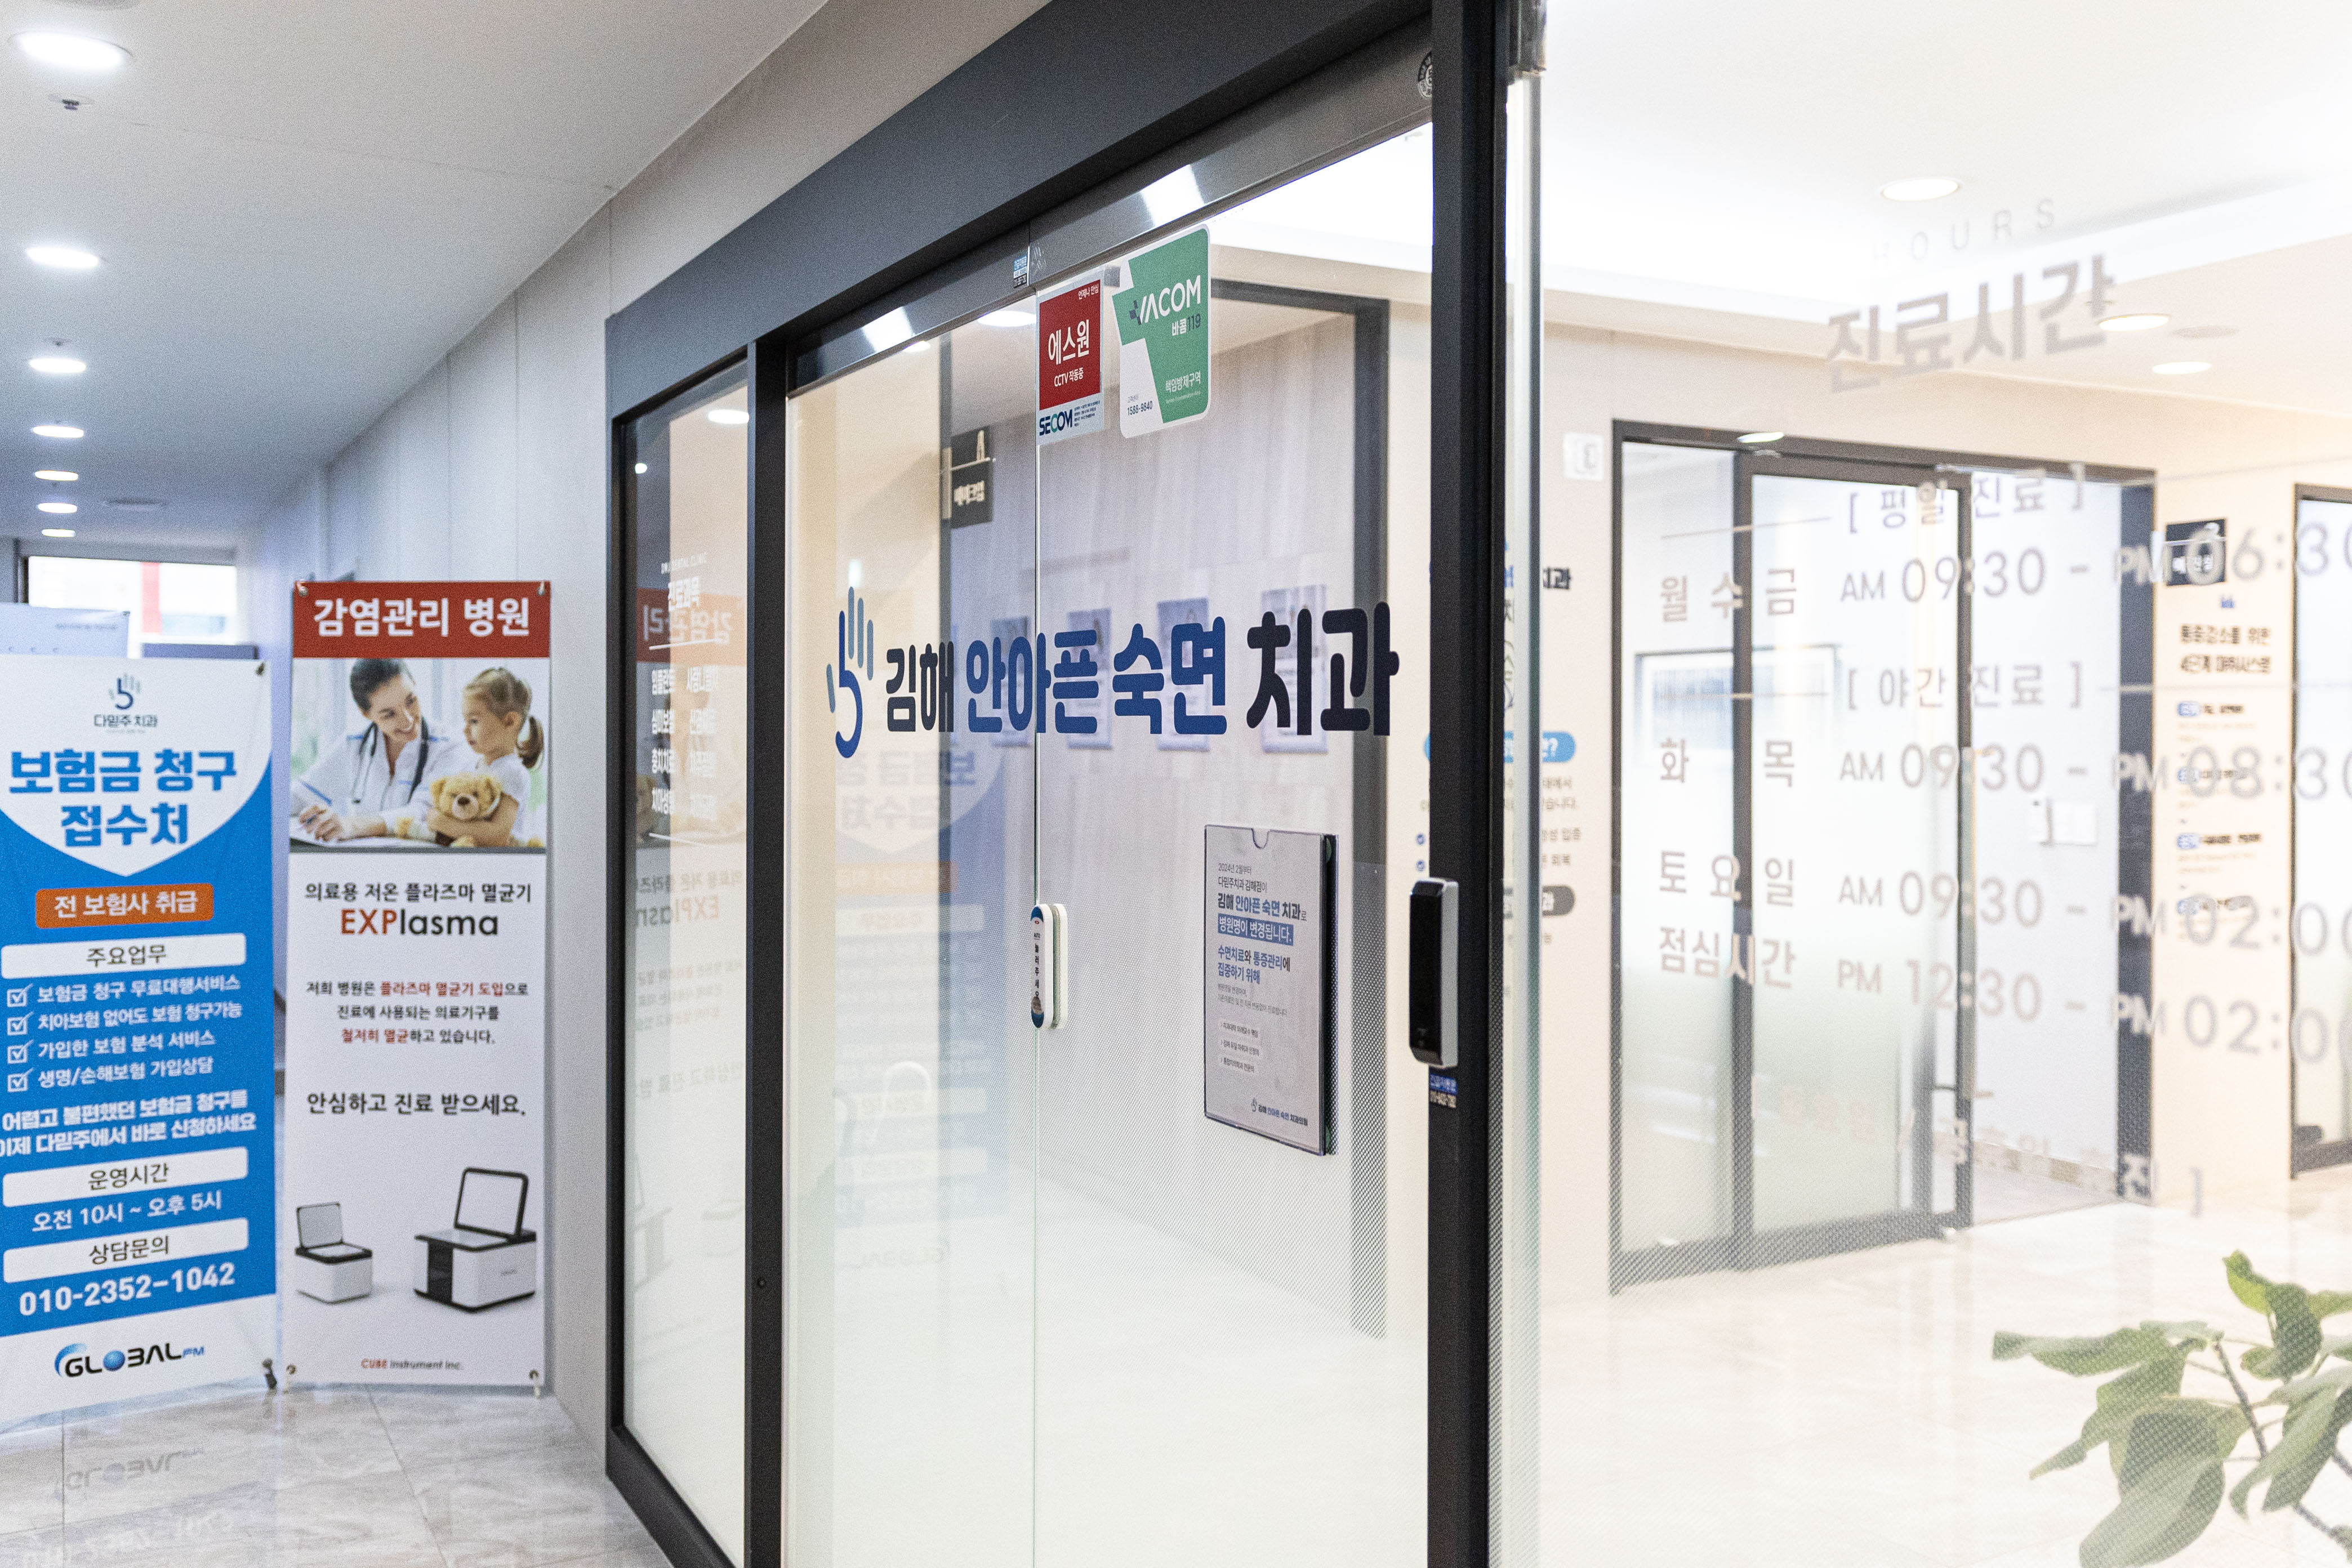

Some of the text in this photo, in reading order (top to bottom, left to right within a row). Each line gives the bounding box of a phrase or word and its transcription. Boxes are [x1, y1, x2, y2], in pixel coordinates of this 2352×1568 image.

[1078, 284, 1099, 300] 언제나 안심
[1827, 253, 2115, 394] 진료시간
[1048, 319, 1090, 365] 에스원
[1054, 367, 1084, 387] CCTV 작동중
[1165, 370, 1201, 393] 책임방제구역
[1039, 409, 1073, 436] SECOM
[1127, 400, 1153, 416] 1588-9840
[1881, 467, 2047, 528] 평일 진료
[1660, 574, 1689, 622] 월
[1711, 572, 1744, 619] 수
[1766, 568, 1797, 616] 금
[1840, 570, 1885, 602] AM
[1902, 547, 2046, 603] 09:30
[2112, 545, 2173, 585] PM
[2185, 522, 2352, 585] 06:3
[314, 597, 529, 638] 감염관리 병원
[886, 602, 1400, 736] 김해 안아픈 숙면 치과
[1879, 664, 2045, 709] 야간 진료
[135, 714, 158, 728] 치과
[8, 749, 237, 794] 보험금 청구
[1660, 738, 2352, 800] 화 목 AM 09:30 PM 08:3
[60, 802, 189, 847] 접수처
[55, 890, 198, 919] 전 보험사 취급
[305, 883, 532, 903] 의료용 저온 플라즈마 멸균기
[1218, 893, 1307, 921] 김해 안아픈 숙면 치과로
[340, 908, 499, 936] EXPlasma
[1839, 875, 1883, 907] AM
[1900, 870, 2044, 929] 09:30
[2112, 894, 2168, 935] PM
[2185, 893, 2352, 956] 02:0
[1219, 916, 1292, 943] 병원명이 변경됩니다.
[87, 945, 167, 968] 주요업무
[1218, 945, 1290, 973] 수면치료와 통증관리에
[1218, 962, 1260, 985] 집중하기 위해
[1659, 926, 1797, 990] 점심시간
[1838, 959, 1882, 994] PM
[1906, 959, 2042, 1022] 12:30
[2110, 992, 2168, 1036] PM
[37, 974, 240, 1004] 보험금 청구 무료대행서비스
[306, 981, 529, 997] 저희 병원은 플라즈마 멸균기 도입으로
[38, 1001, 243, 1032] 치아보험 없어도 보험 청구가능
[337, 1005, 500, 1021] 진료에 사용되는 의료기구를
[39, 1029, 215, 1060] 가입한 보험 분석 서비스
[341, 1028, 496, 1044] 철저히 멸균하고 있습니다.
[38, 1056, 213, 1089] 생명/손해보험 가입상담
[2, 1088, 248, 1132] 어렵고 불편했던 보험금 청구를
[308, 1092, 525, 1117] 안심하고 진료 받으세요.
[0, 1135, 30, 1158] 이제
[131, 1121, 167, 1143] 바로
[171, 1111, 257, 1139] 신청하세요
[88, 1162, 170, 1191] 운영시간
[32, 1209, 73, 1232] 오전
[80, 1201, 124, 1226] 10시
[147, 1194, 185, 1218] 오후
[191, 1189, 223, 1212] 5시
[89, 1235, 170, 1266] 상담문의
[19, 1262, 235, 1316] 010-2352-1042
[360, 1357, 388, 1370] CUBE
